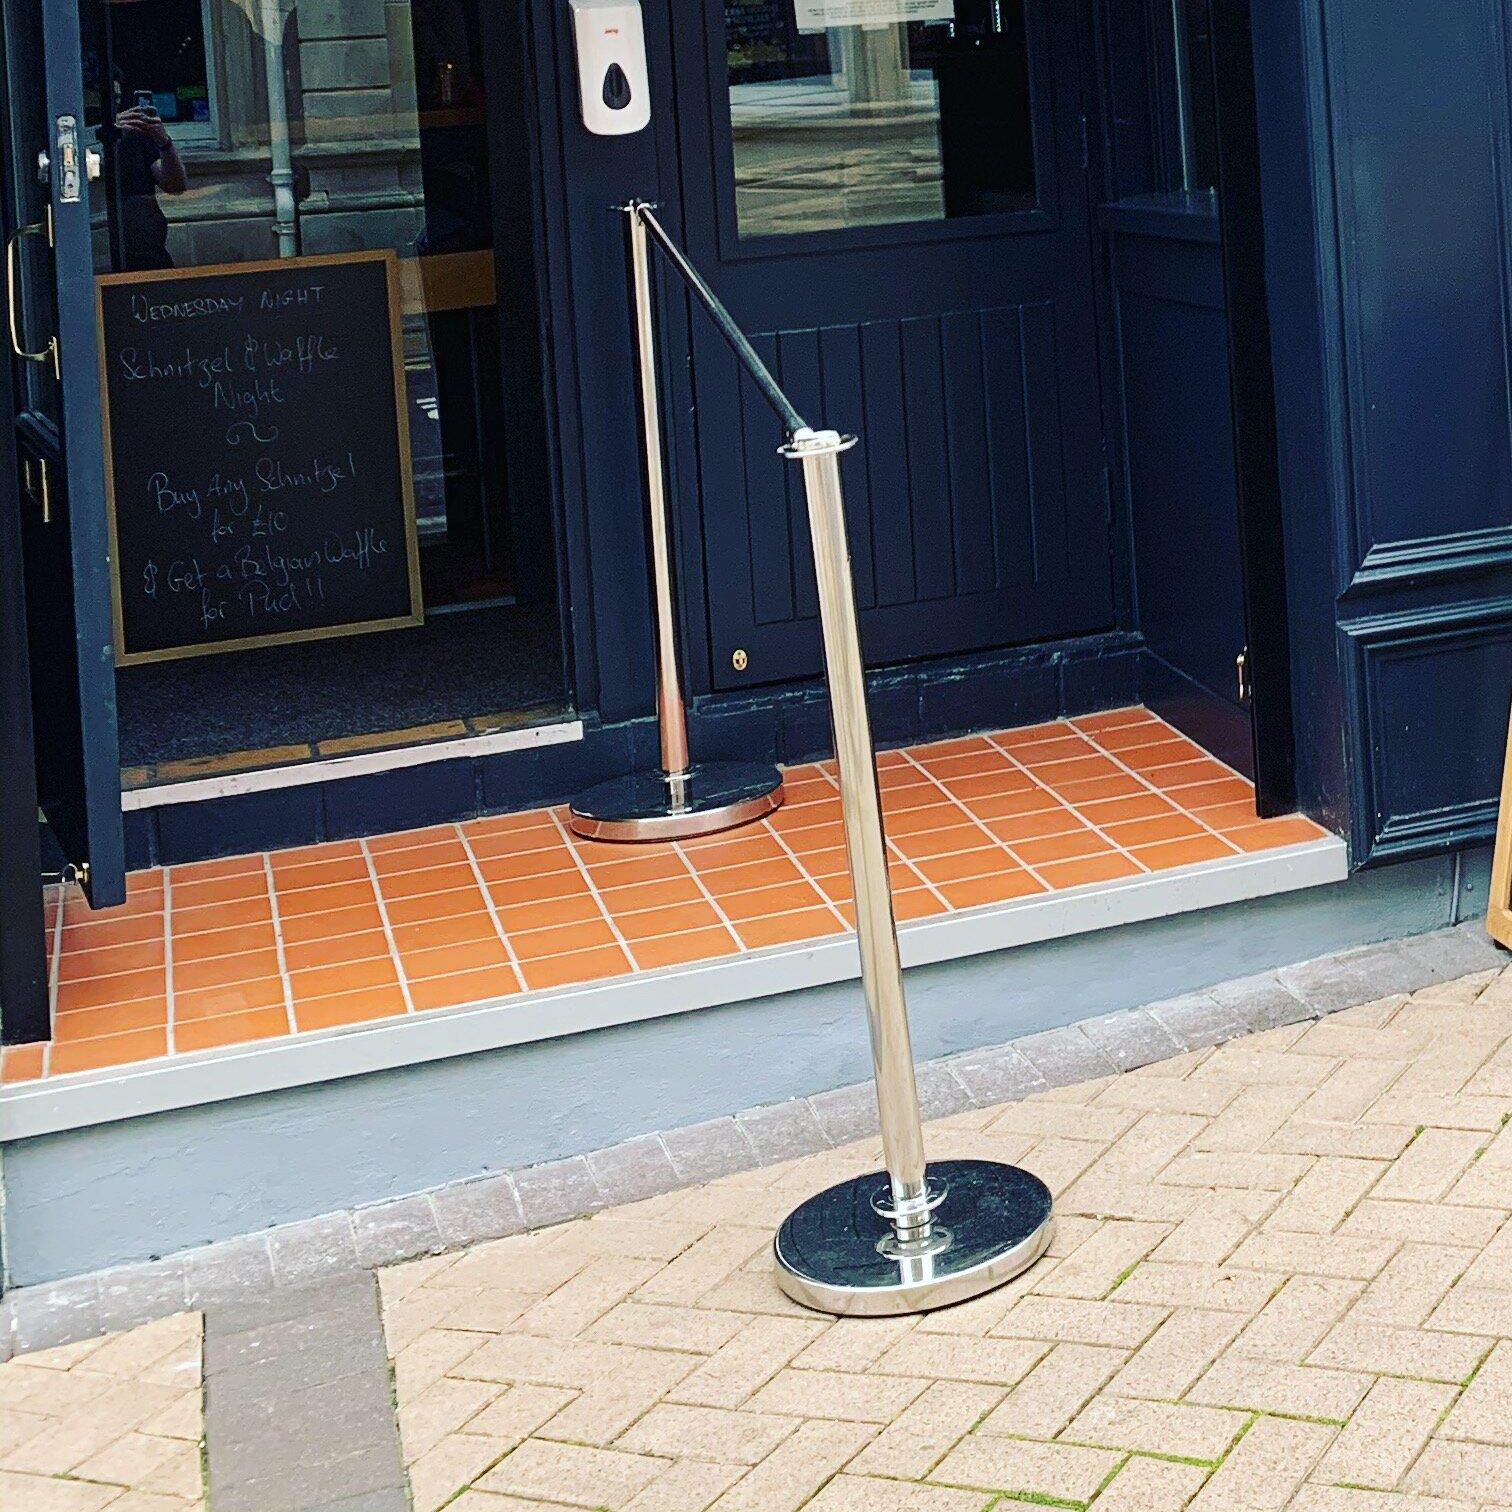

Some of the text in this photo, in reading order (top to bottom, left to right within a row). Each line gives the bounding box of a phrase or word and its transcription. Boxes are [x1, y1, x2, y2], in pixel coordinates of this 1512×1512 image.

[131, 287, 324, 324] WEDNESDAY NIGHT
[119, 346, 232, 388] Schnitzel
[267, 335, 339, 375] Waffle
[212, 380, 286, 416] Night
[147, 472, 201, 519] Buy
[255, 452, 357, 493] Schnitzel
[211, 508, 234, 544] for
[167, 559, 206, 592] Get
[217, 564, 232, 579] a
[235, 544, 321, 586] Belgian
[200, 588, 225, 630] for
